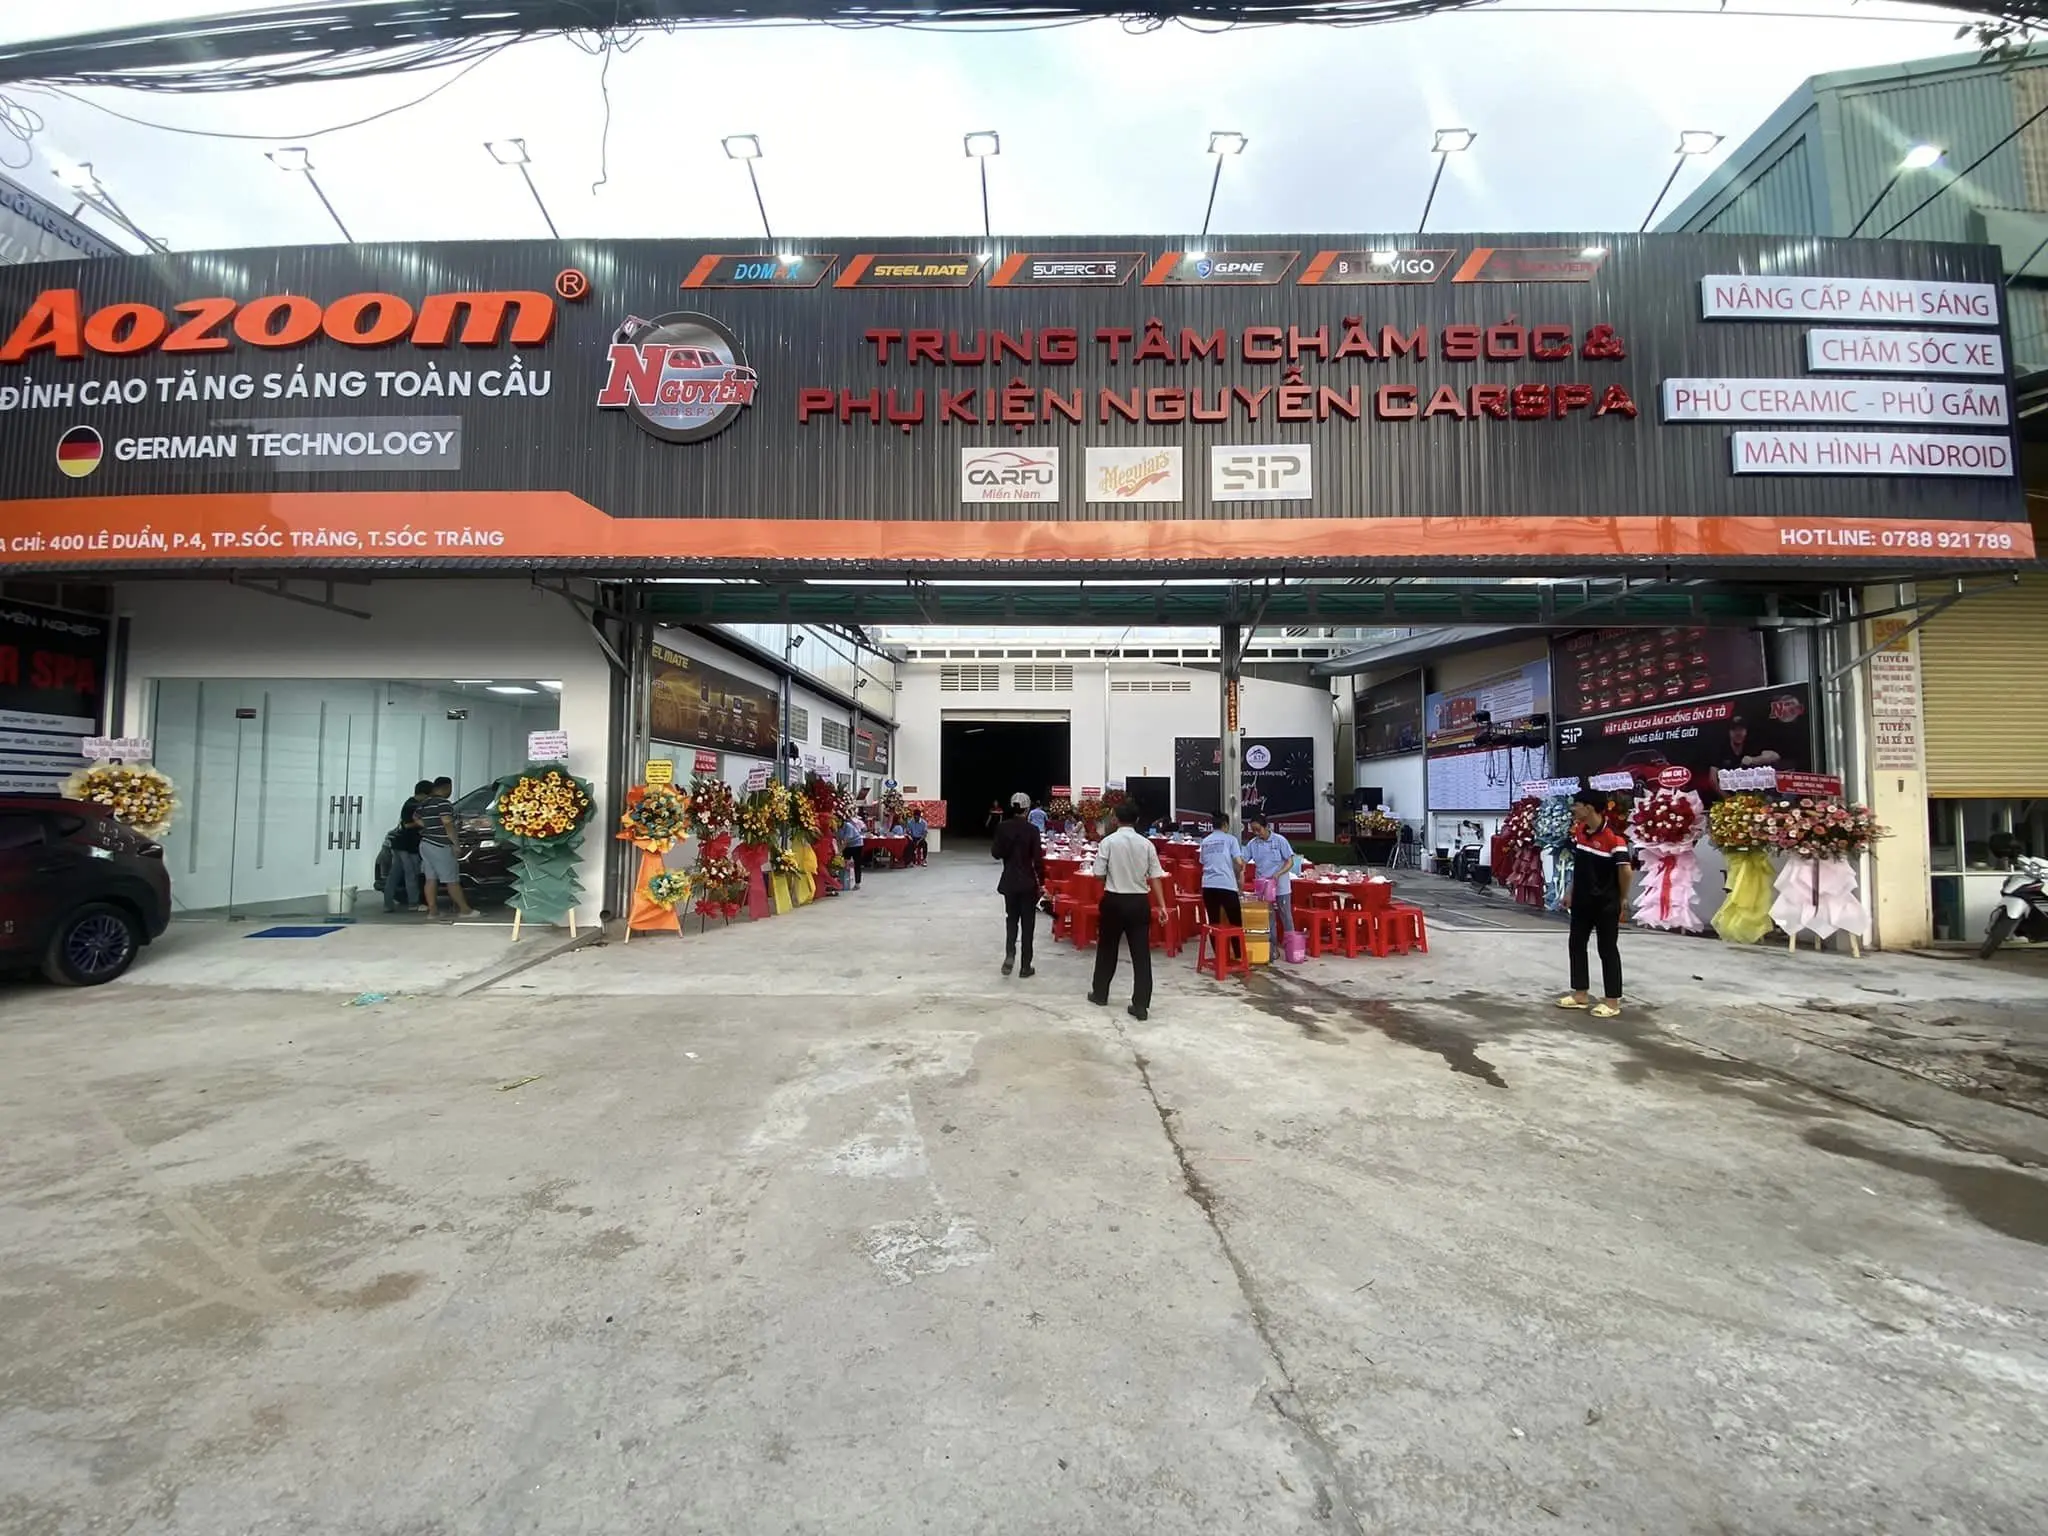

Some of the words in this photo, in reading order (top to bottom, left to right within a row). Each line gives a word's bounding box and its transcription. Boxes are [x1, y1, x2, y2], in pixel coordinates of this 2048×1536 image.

[1214, 262, 1265, 273] GPNE
[1716, 283, 1793, 310] NÂNG
[1801, 282, 1851, 311] CẤP
[1860, 285, 1914, 313] ÁNH
[1920, 287, 1988, 316] SÁNG
[864, 327, 1078, 366] TRUNG
[1096, 315, 1226, 365] TÂM
[1242, 315, 1430, 363] CHĂM
[1443, 314, 1574, 362] SÓC
[1581, 323, 1628, 359] &
[1822, 336, 1901, 364] CHĂM
[1908, 337, 1958, 365] SÓC
[1965, 343, 1995, 366] XE
[0, 374, 74, 411] ĐỈNH
[81, 377, 147, 406] CAO
[157, 369, 254, 402] TĂNG
[262, 363, 367, 400] SÁNG
[374, 360, 472, 398] TOÀN
[477, 354, 551, 397] CẦU
[800, 387, 925, 434] PHỤ
[940, 377, 1082, 434] KIỆN
[1100, 365, 1360, 425] NGUYỄN
[1376, 383, 1638, 422] CARSPA
[1676, 383, 1731, 412] PHỦ
[1740, 389, 1858, 413] CERAMIC
[1883, 386, 1933, 414] PHỦ
[115, 435, 237, 461] GERMAN
[246, 430, 454, 458] TECHNOLOGY
[1745, 440, 1808, 464] MÀN
[1817, 439, 1881, 465] HÌNH
[1890, 443, 2006, 468] ANDROID
[968, 469, 1053, 485] CARFU
[1014, 489, 1041, 499] Nam
[12, 531, 45, 551] CHỈ:
[50, 535, 83, 550] 400
[88, 530, 109, 549] LÊ
[112, 525, 168, 551] DUẨN,
[173, 532, 206, 551] P.4,
[211, 525, 283, 547] TP.SÓC
[290, 527, 363, 549] TRĂNG,
[367, 525, 427, 547] T.SÓC
[433, 526, 504, 547] TRĂNG
[1781, 528, 1876, 546] HOTLINE:
[1881, 530, 1933, 547] 0788
[1937, 531, 1976, 548] 921
[1977, 533, 2013, 550] 789
